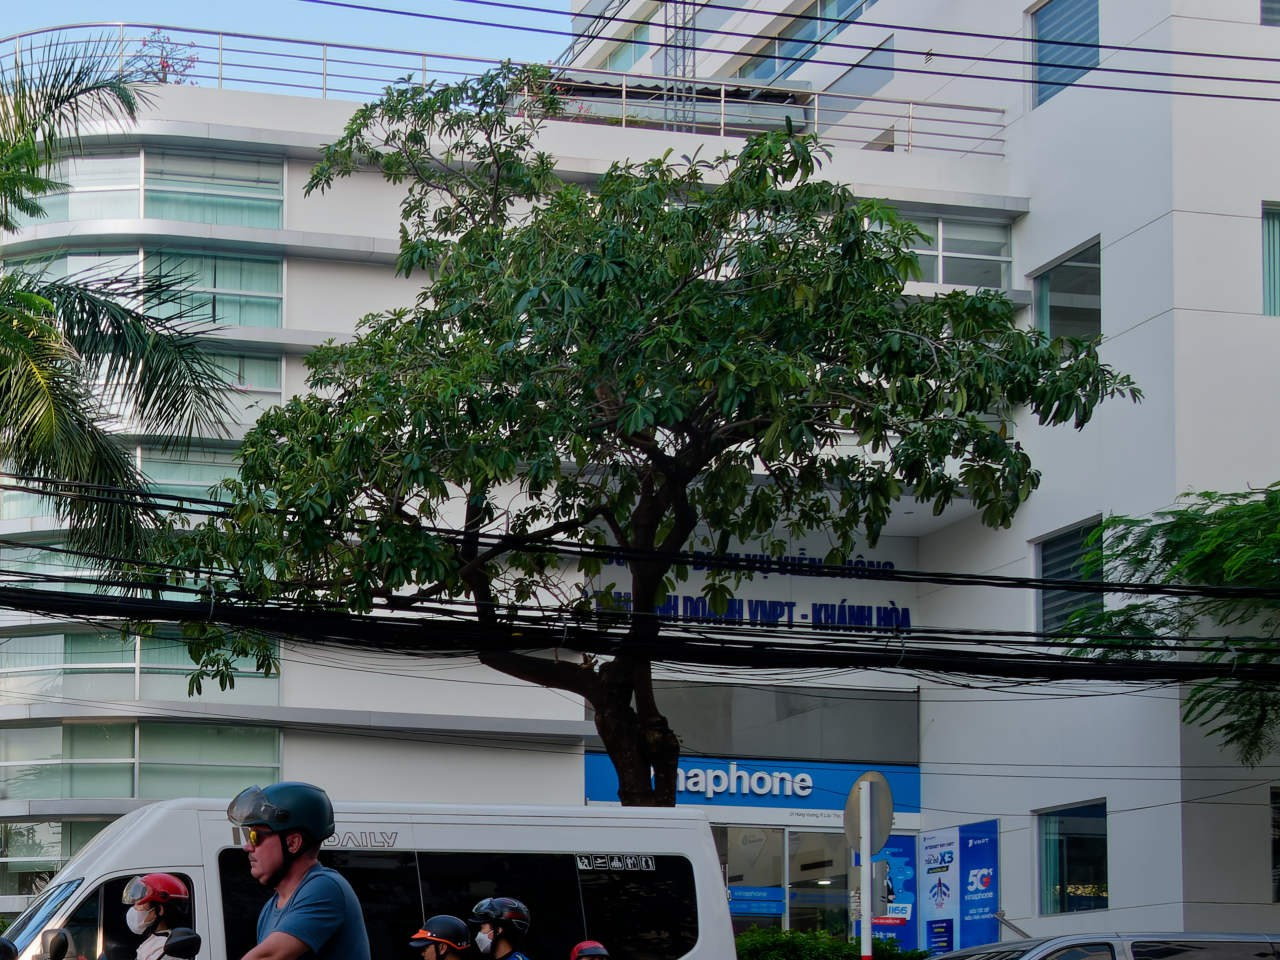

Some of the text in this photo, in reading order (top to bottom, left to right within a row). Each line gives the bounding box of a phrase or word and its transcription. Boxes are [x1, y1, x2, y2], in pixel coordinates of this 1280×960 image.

[748, 600, 796, 627] VNPT
[812, 599, 872, 631] KHÁNH
[876, 601, 911, 633] HÒA
